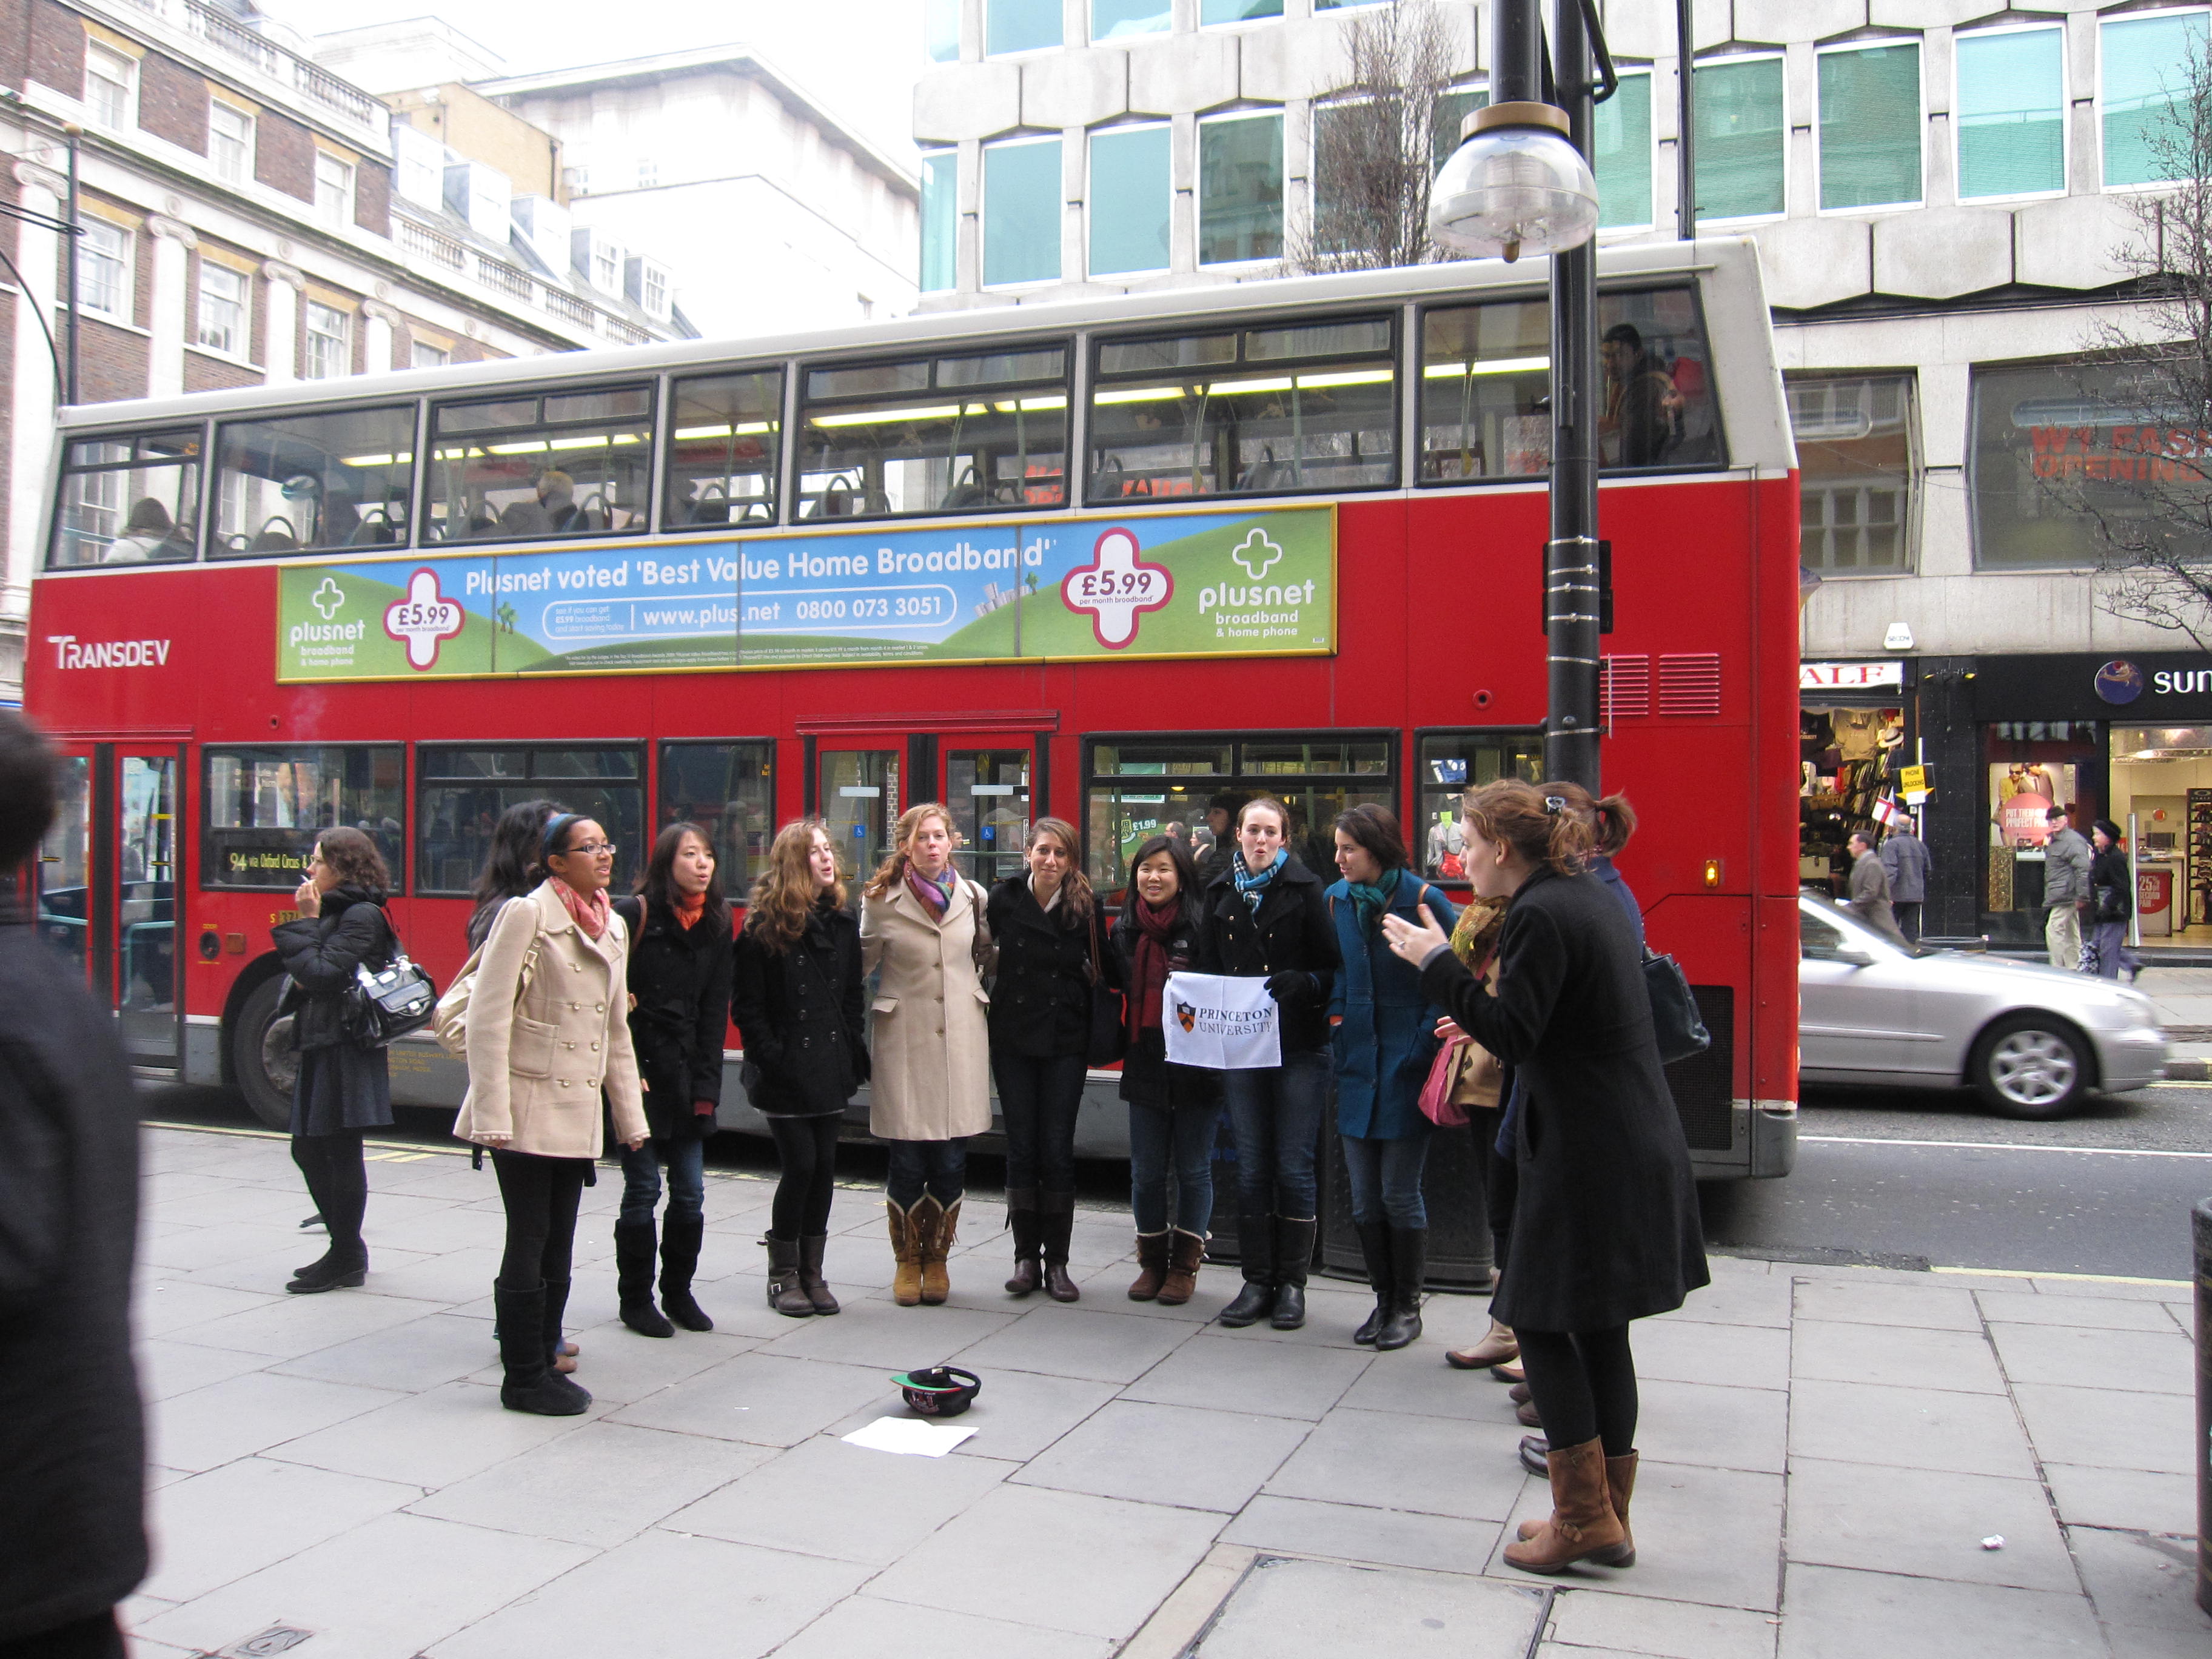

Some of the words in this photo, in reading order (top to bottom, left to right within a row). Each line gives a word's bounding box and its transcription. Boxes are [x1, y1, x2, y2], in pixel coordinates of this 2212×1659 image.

[466, 566, 551, 595] Plusnet
[557, 561, 628, 589] voted
[706, 553, 780, 582] Value
[789, 552, 869, 577] Home
[1082, 570, 1151, 595] £5.99
[1199, 578, 1315, 614] plusnet
[398, 603, 449, 625] £5.99
[643, 602, 781, 628] www.plus.net
[796, 600, 846, 620] 0800
[853, 598, 889, 617] 073
[895, 596, 940, 616] 3051
[1216, 609, 1299, 625] broadband
[290, 619, 366, 647] plusnet
[1216, 628, 1225, 637] &
[1228, 627, 1259, 637] home
[1263, 626, 1298, 638] phone
[47, 635, 171, 669] TRANSDEV
[300, 645, 355, 655] broadband
[230, 853, 247, 871] 94
[1199, 1007, 1272, 1022] PRINCETON
[1199, 1022, 1272, 1036] UNIVERSITY
